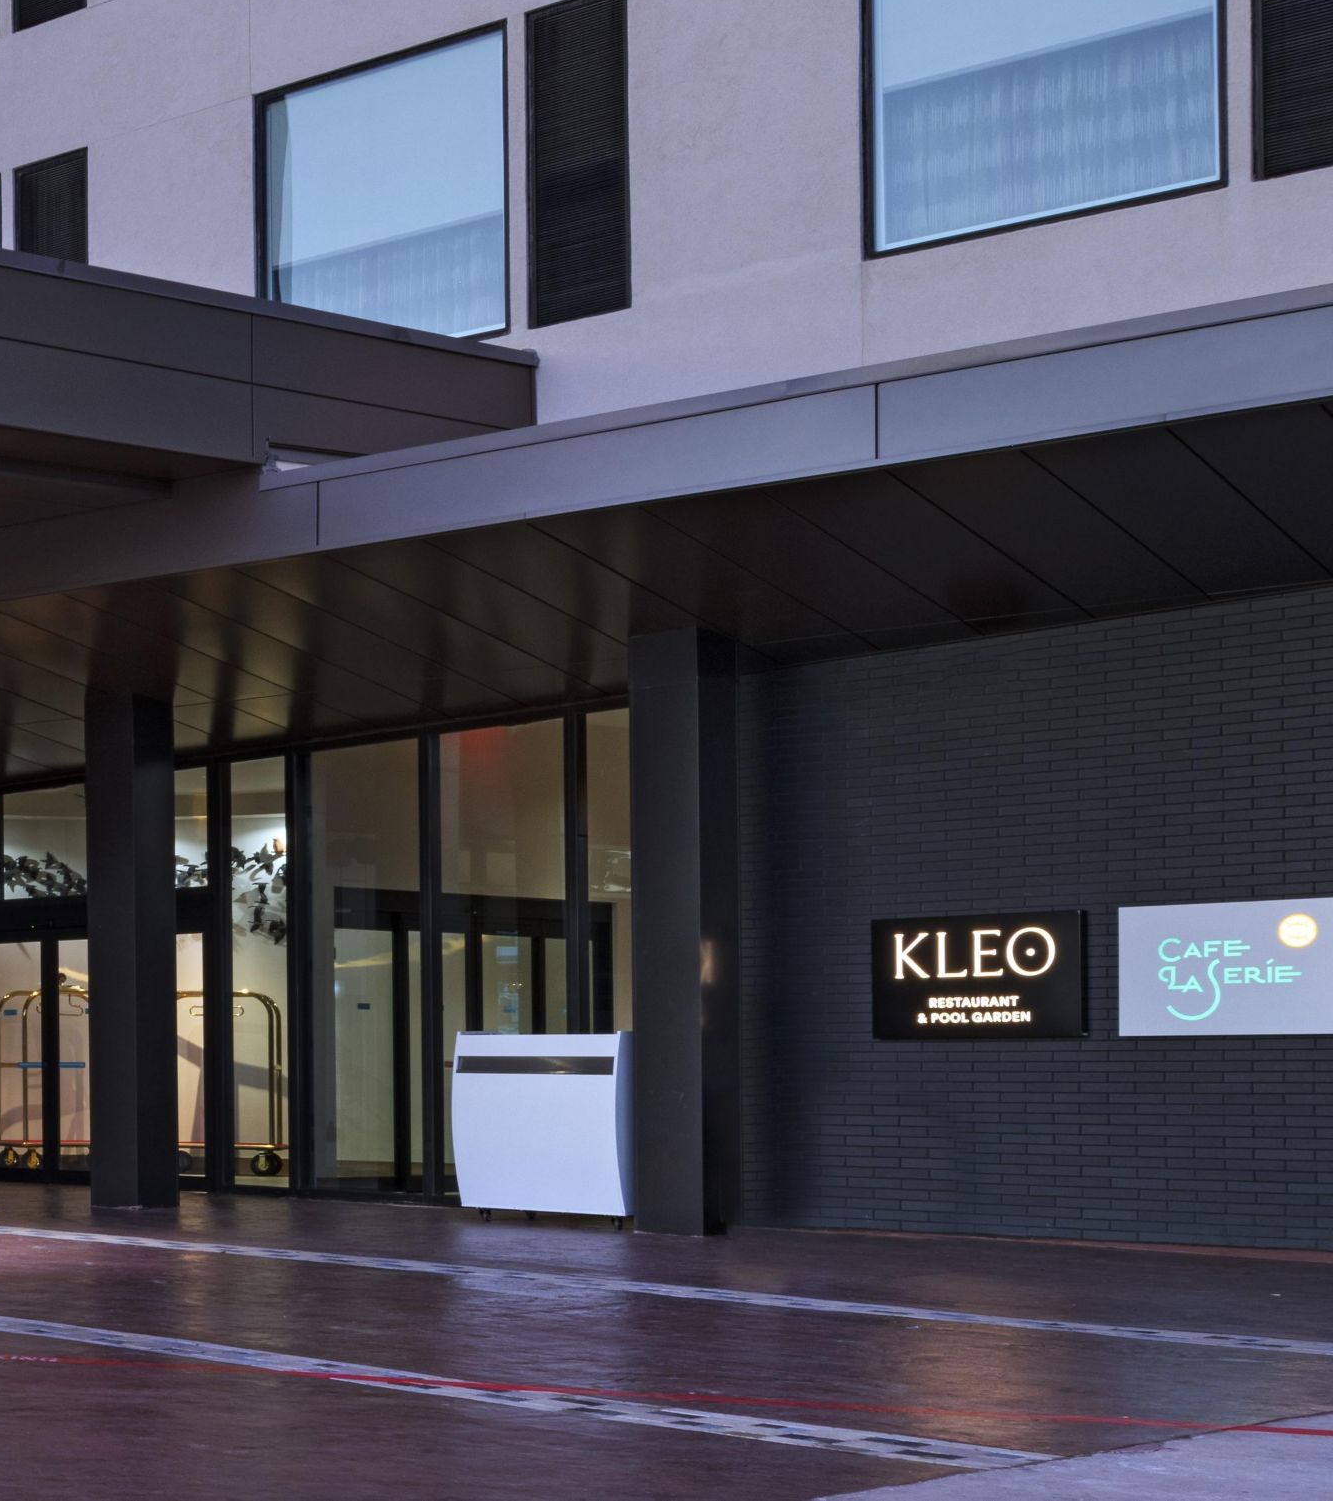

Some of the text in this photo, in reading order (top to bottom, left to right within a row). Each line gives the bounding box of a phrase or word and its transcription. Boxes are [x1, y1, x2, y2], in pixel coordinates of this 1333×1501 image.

[893, 926, 1057, 980] KLEO
[1157, 937, 1251, 963] CAFE
[1157, 965, 1204, 993] LA
[928, 995, 1020, 1009] RESTAURANT
[916, 1010, 1031, 1024] & POOL GARDEN
